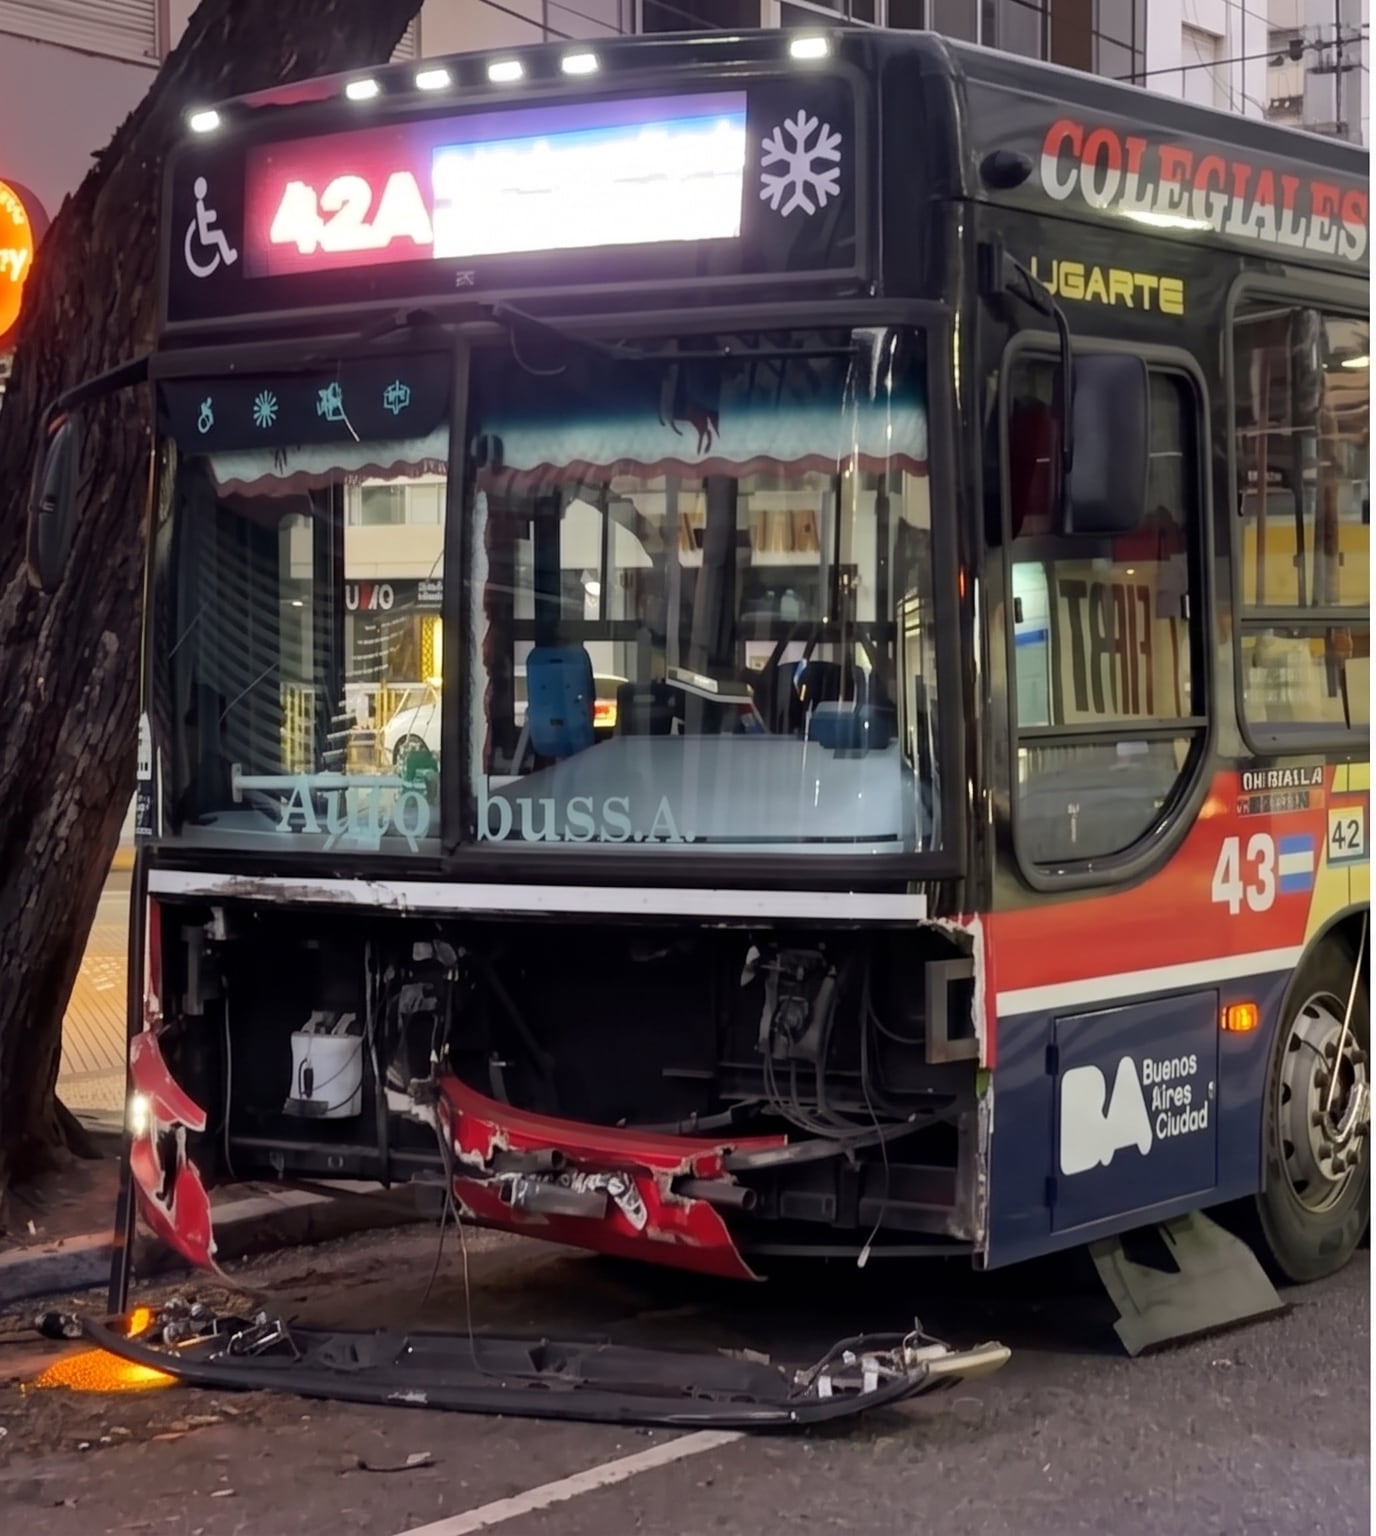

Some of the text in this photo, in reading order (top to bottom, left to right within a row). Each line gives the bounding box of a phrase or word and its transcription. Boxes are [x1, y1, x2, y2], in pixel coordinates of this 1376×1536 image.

[269, 171, 433, 254] 42A
[1040, 119, 1369, 262] COLEGIALES
[1031, 256, 1184, 316] UGARTE
[276, 772, 431, 838] Auto
[1331, 819, 1360, 850] 42
[1211, 832, 1276, 915] 43
[1142, 1054, 1198, 1086] Buenos
[1151, 1084, 1192, 1111] Aires
[1060, 1056, 1153, 1176] BA
[1156, 1100, 1209, 1140] Ciudad
